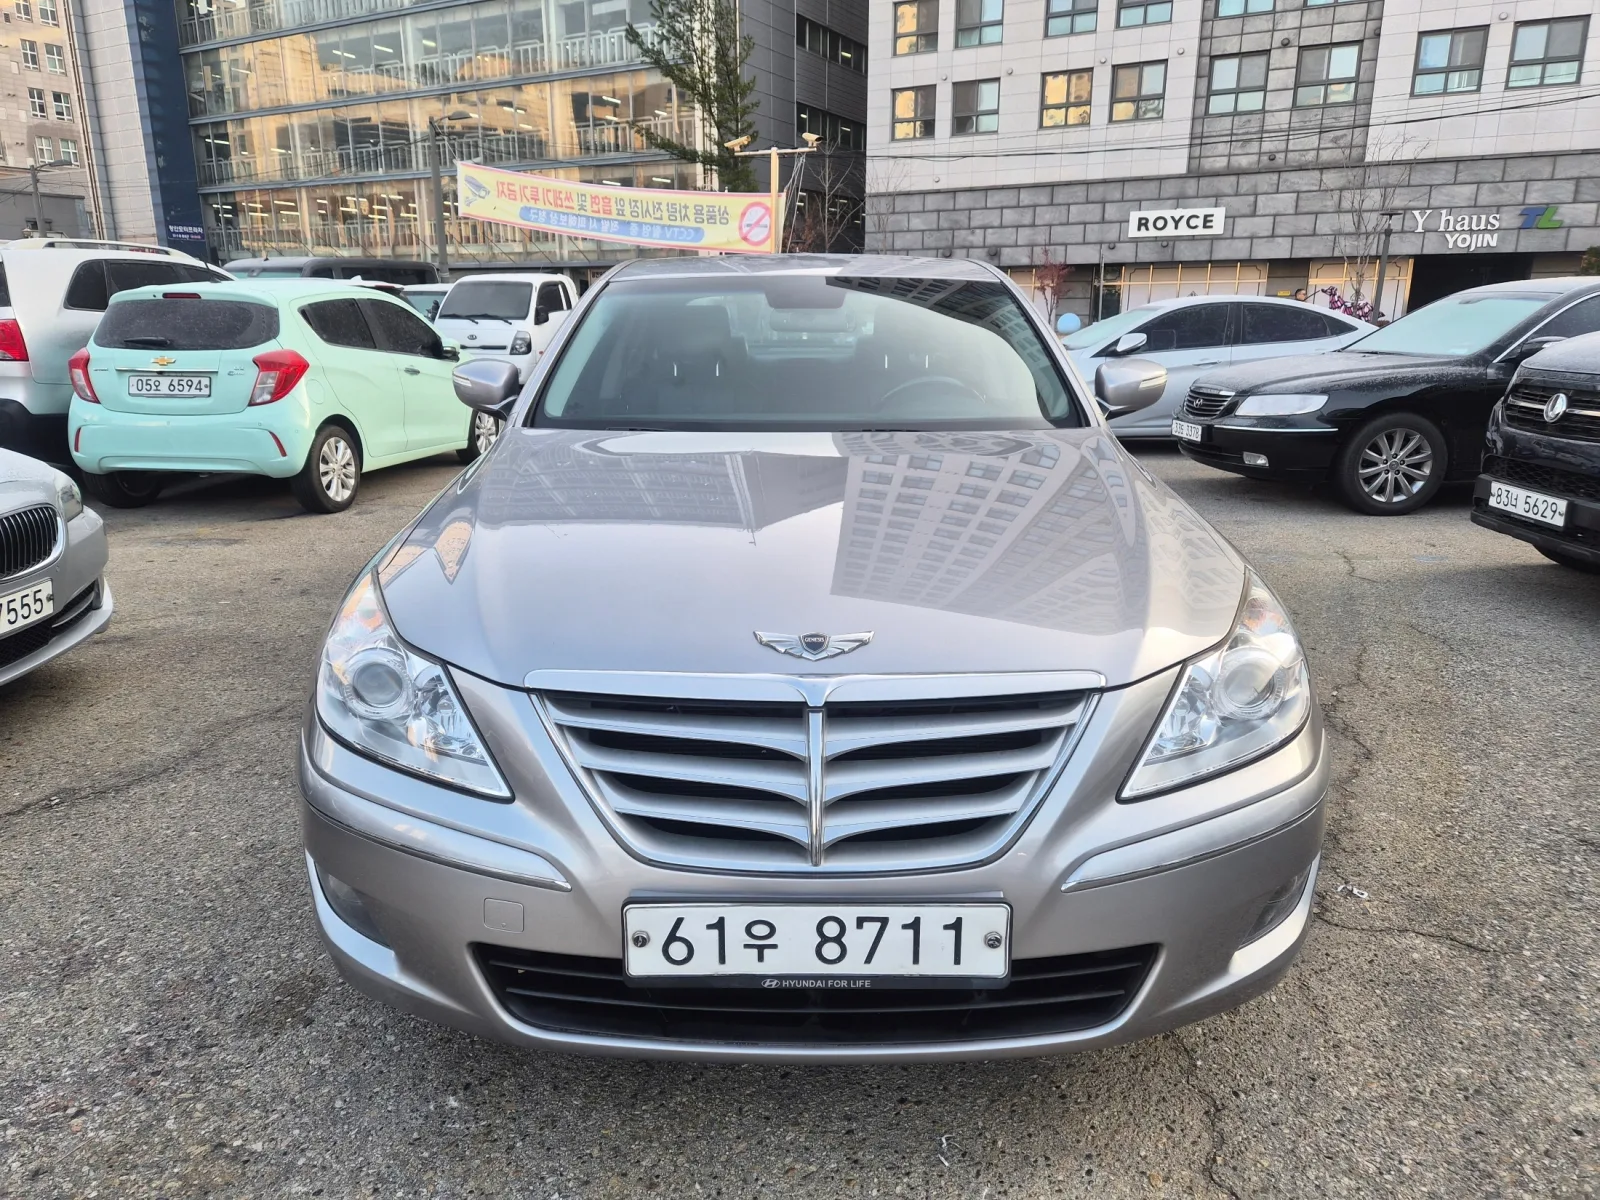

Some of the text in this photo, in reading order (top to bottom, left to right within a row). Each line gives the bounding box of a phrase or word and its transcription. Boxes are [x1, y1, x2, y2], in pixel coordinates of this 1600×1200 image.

[1137, 214, 1214, 232] ROYCE
[1412, 209, 1500, 233] Y haus
[1519, 206, 1563, 229] TL
[1444, 233, 1498, 252] YOJIN
[136, 378, 203, 393] 05오 6594
[1495, 487, 1519, 509] 83너
[1523, 495, 1558, 520] 5629
[0, 588, 44, 625] 555
[661, 915, 963, 966] 61우 8711
[782, 979, 871, 988] HYUNDAI FOR LIFE
